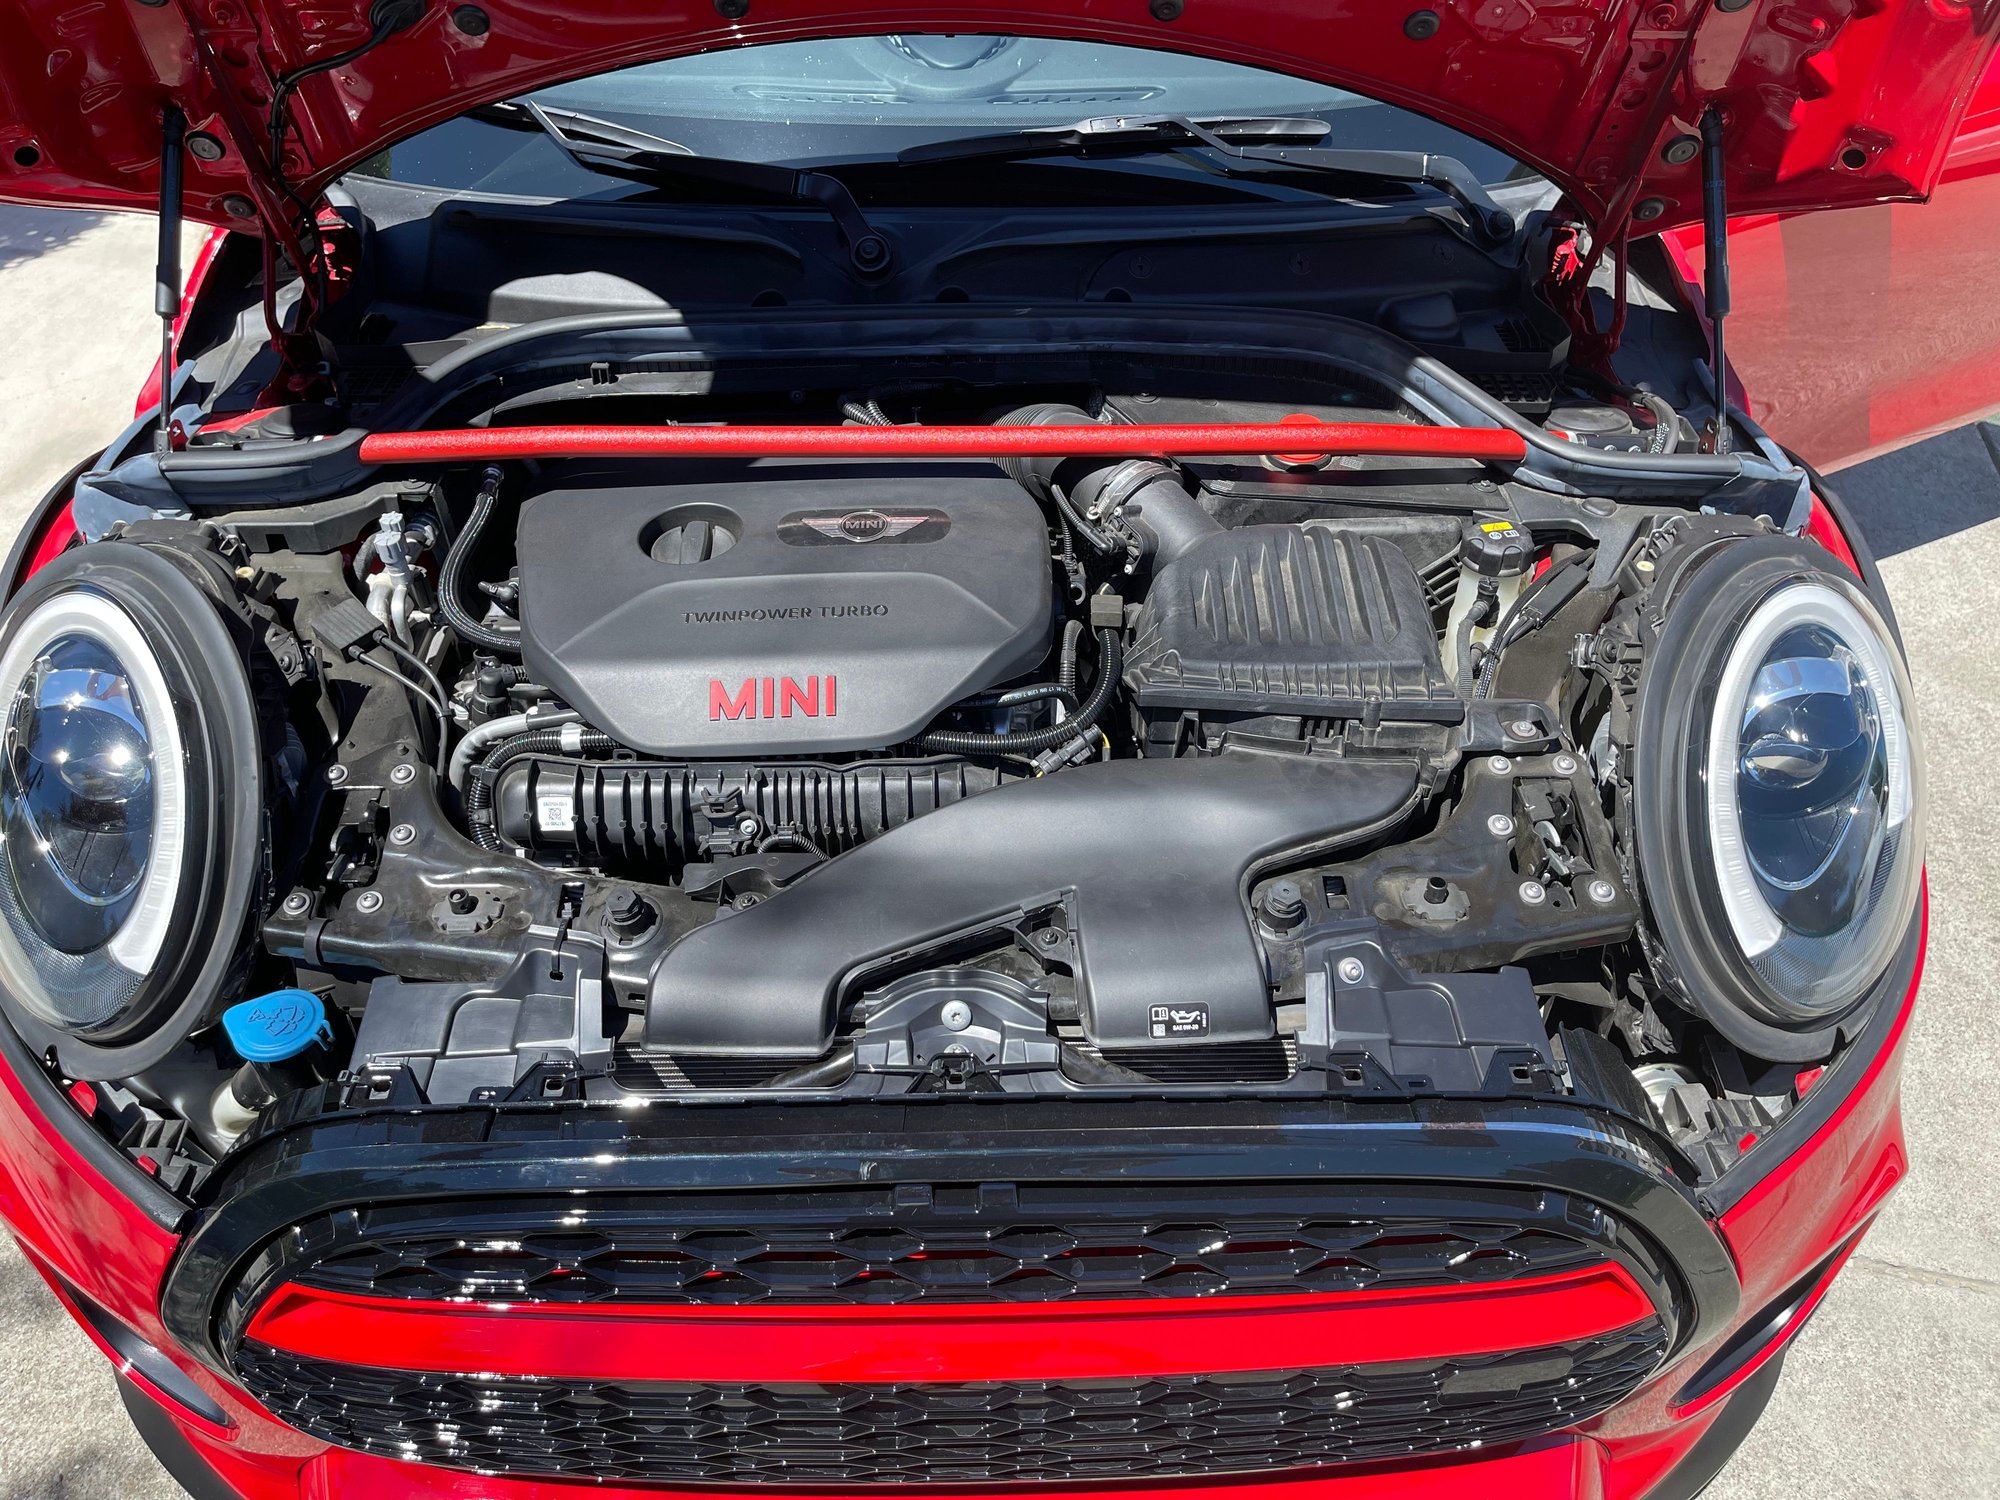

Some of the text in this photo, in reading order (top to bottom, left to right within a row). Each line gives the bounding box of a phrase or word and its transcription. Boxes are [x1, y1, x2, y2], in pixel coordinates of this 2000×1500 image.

[846, 519, 883, 529] MINI
[682, 604, 889, 624] TWINPOWER TURBO
[709, 675, 837, 722] MINI
